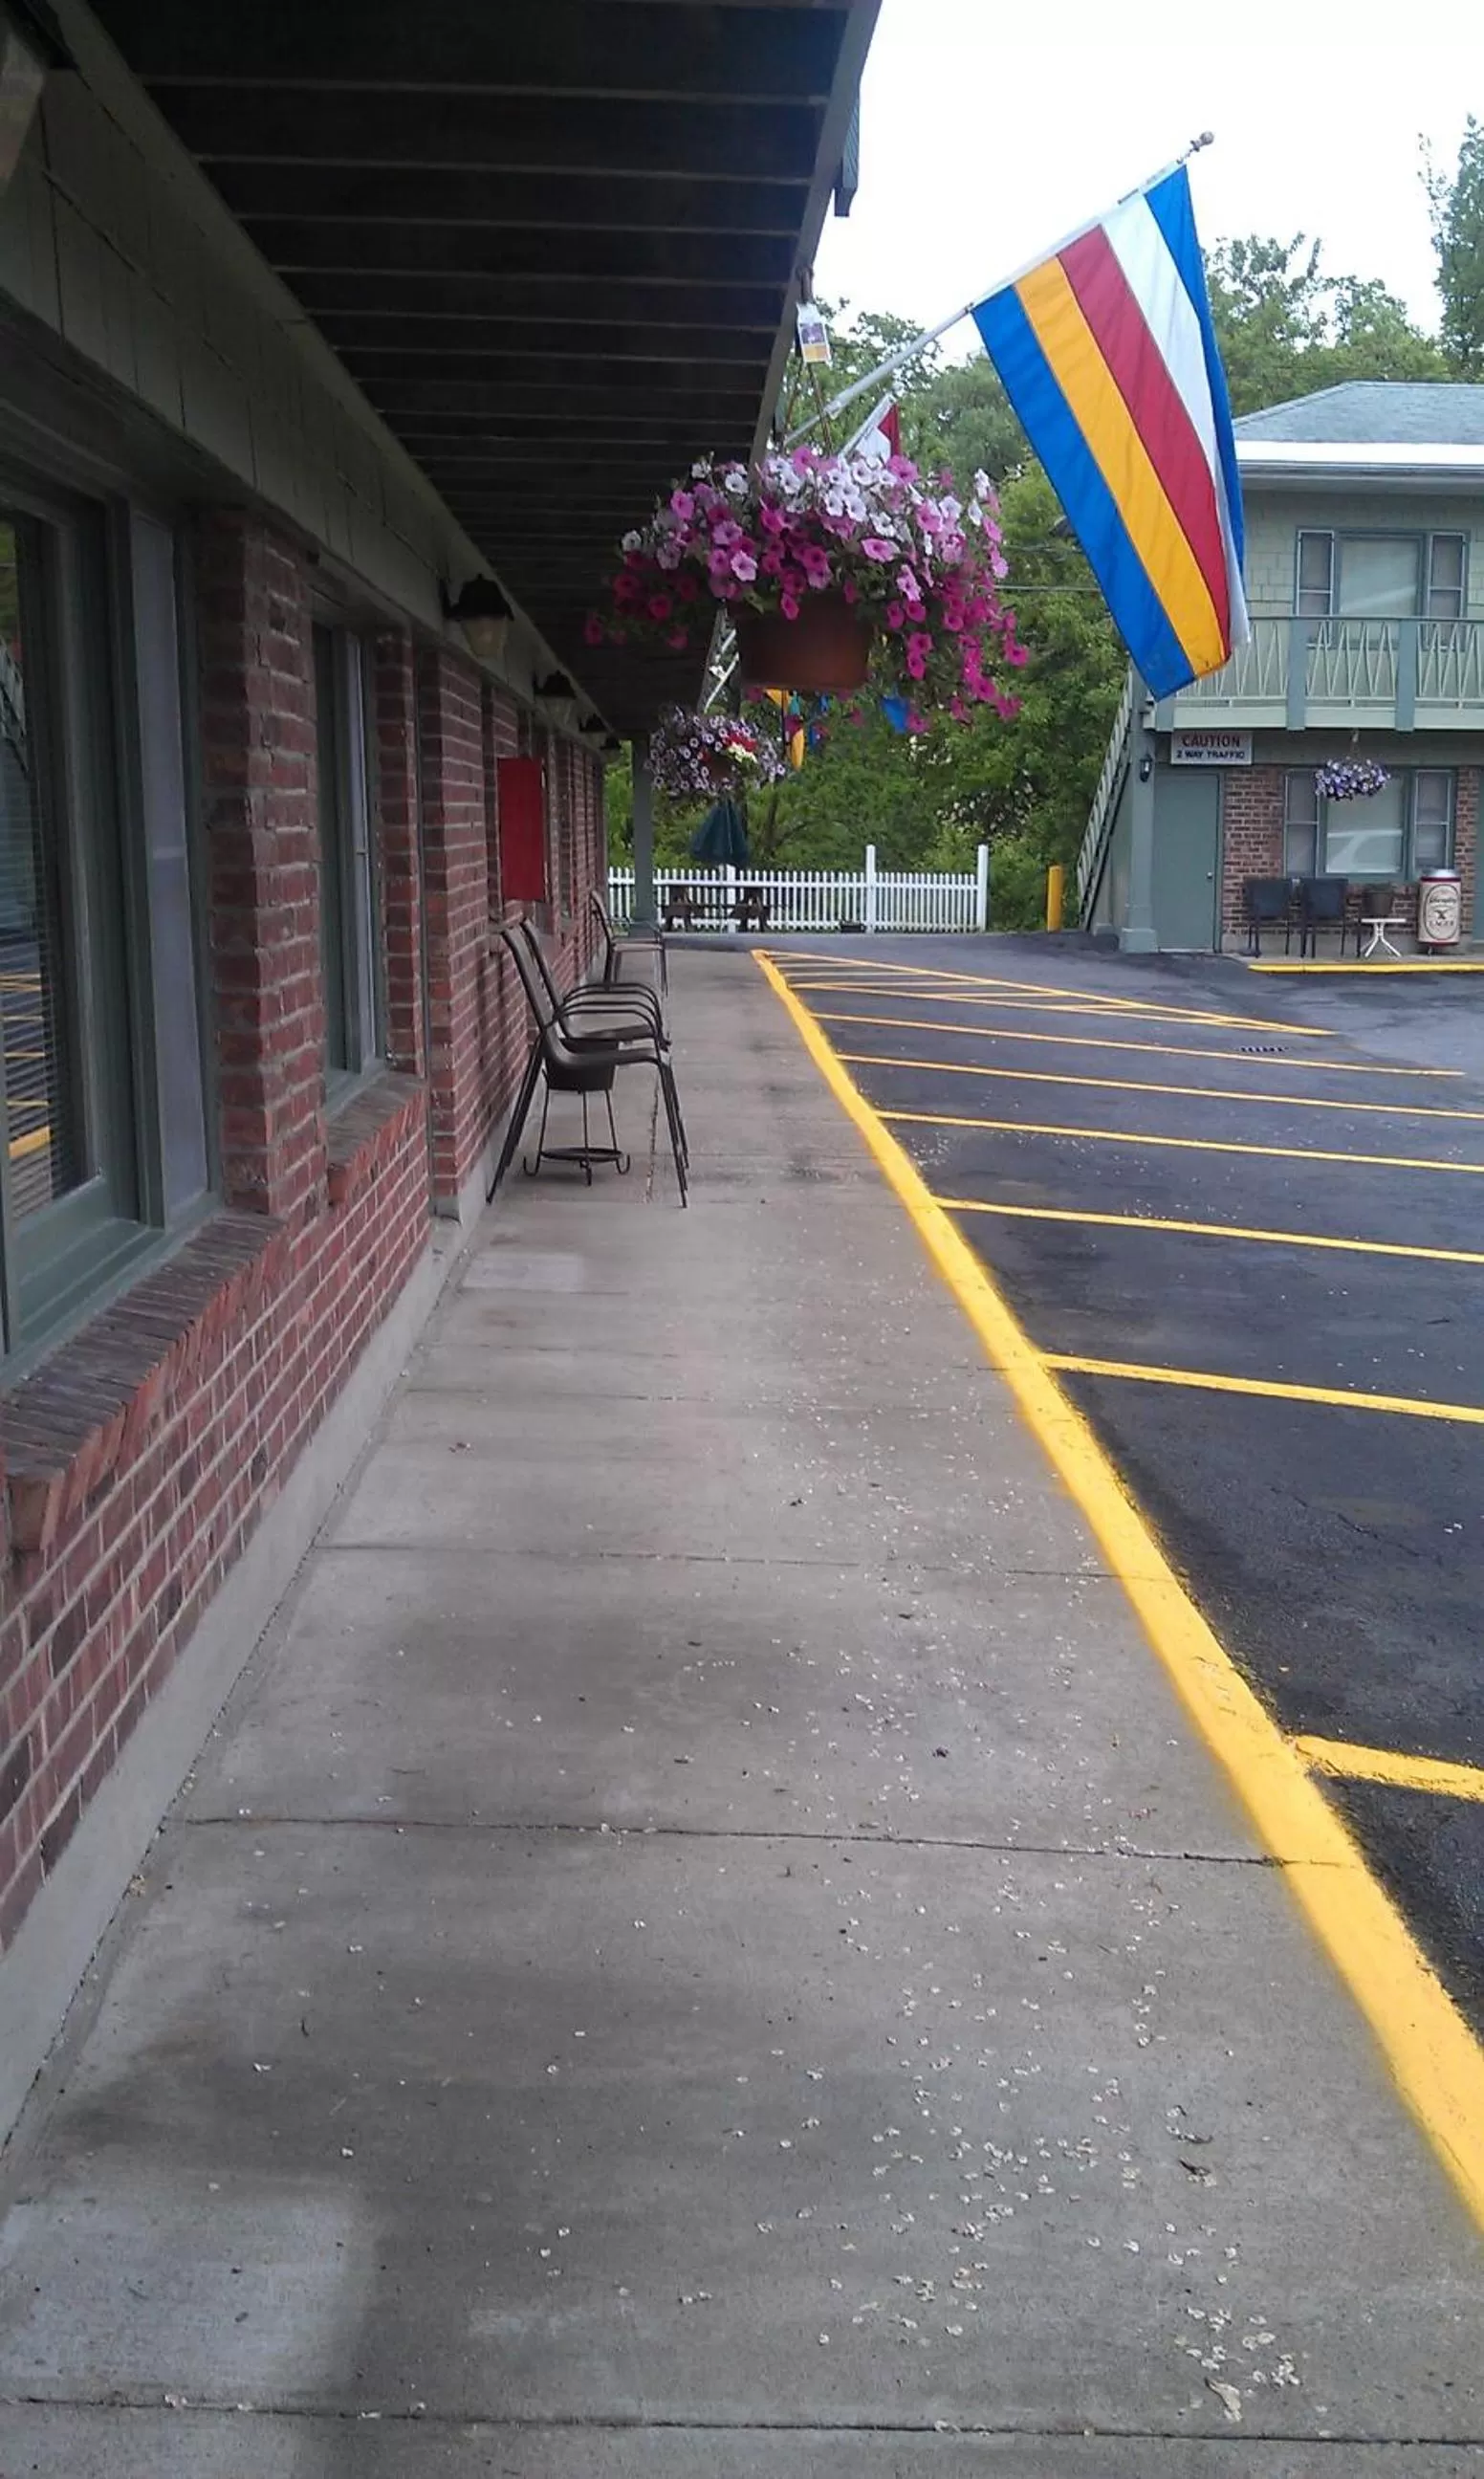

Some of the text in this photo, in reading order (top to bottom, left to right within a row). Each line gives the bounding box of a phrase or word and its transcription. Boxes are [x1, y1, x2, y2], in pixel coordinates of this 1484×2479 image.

[1182, 734, 1240, 747] CAUTION
[1176, 750, 1245, 759] 2 WAY TRAFFIC
